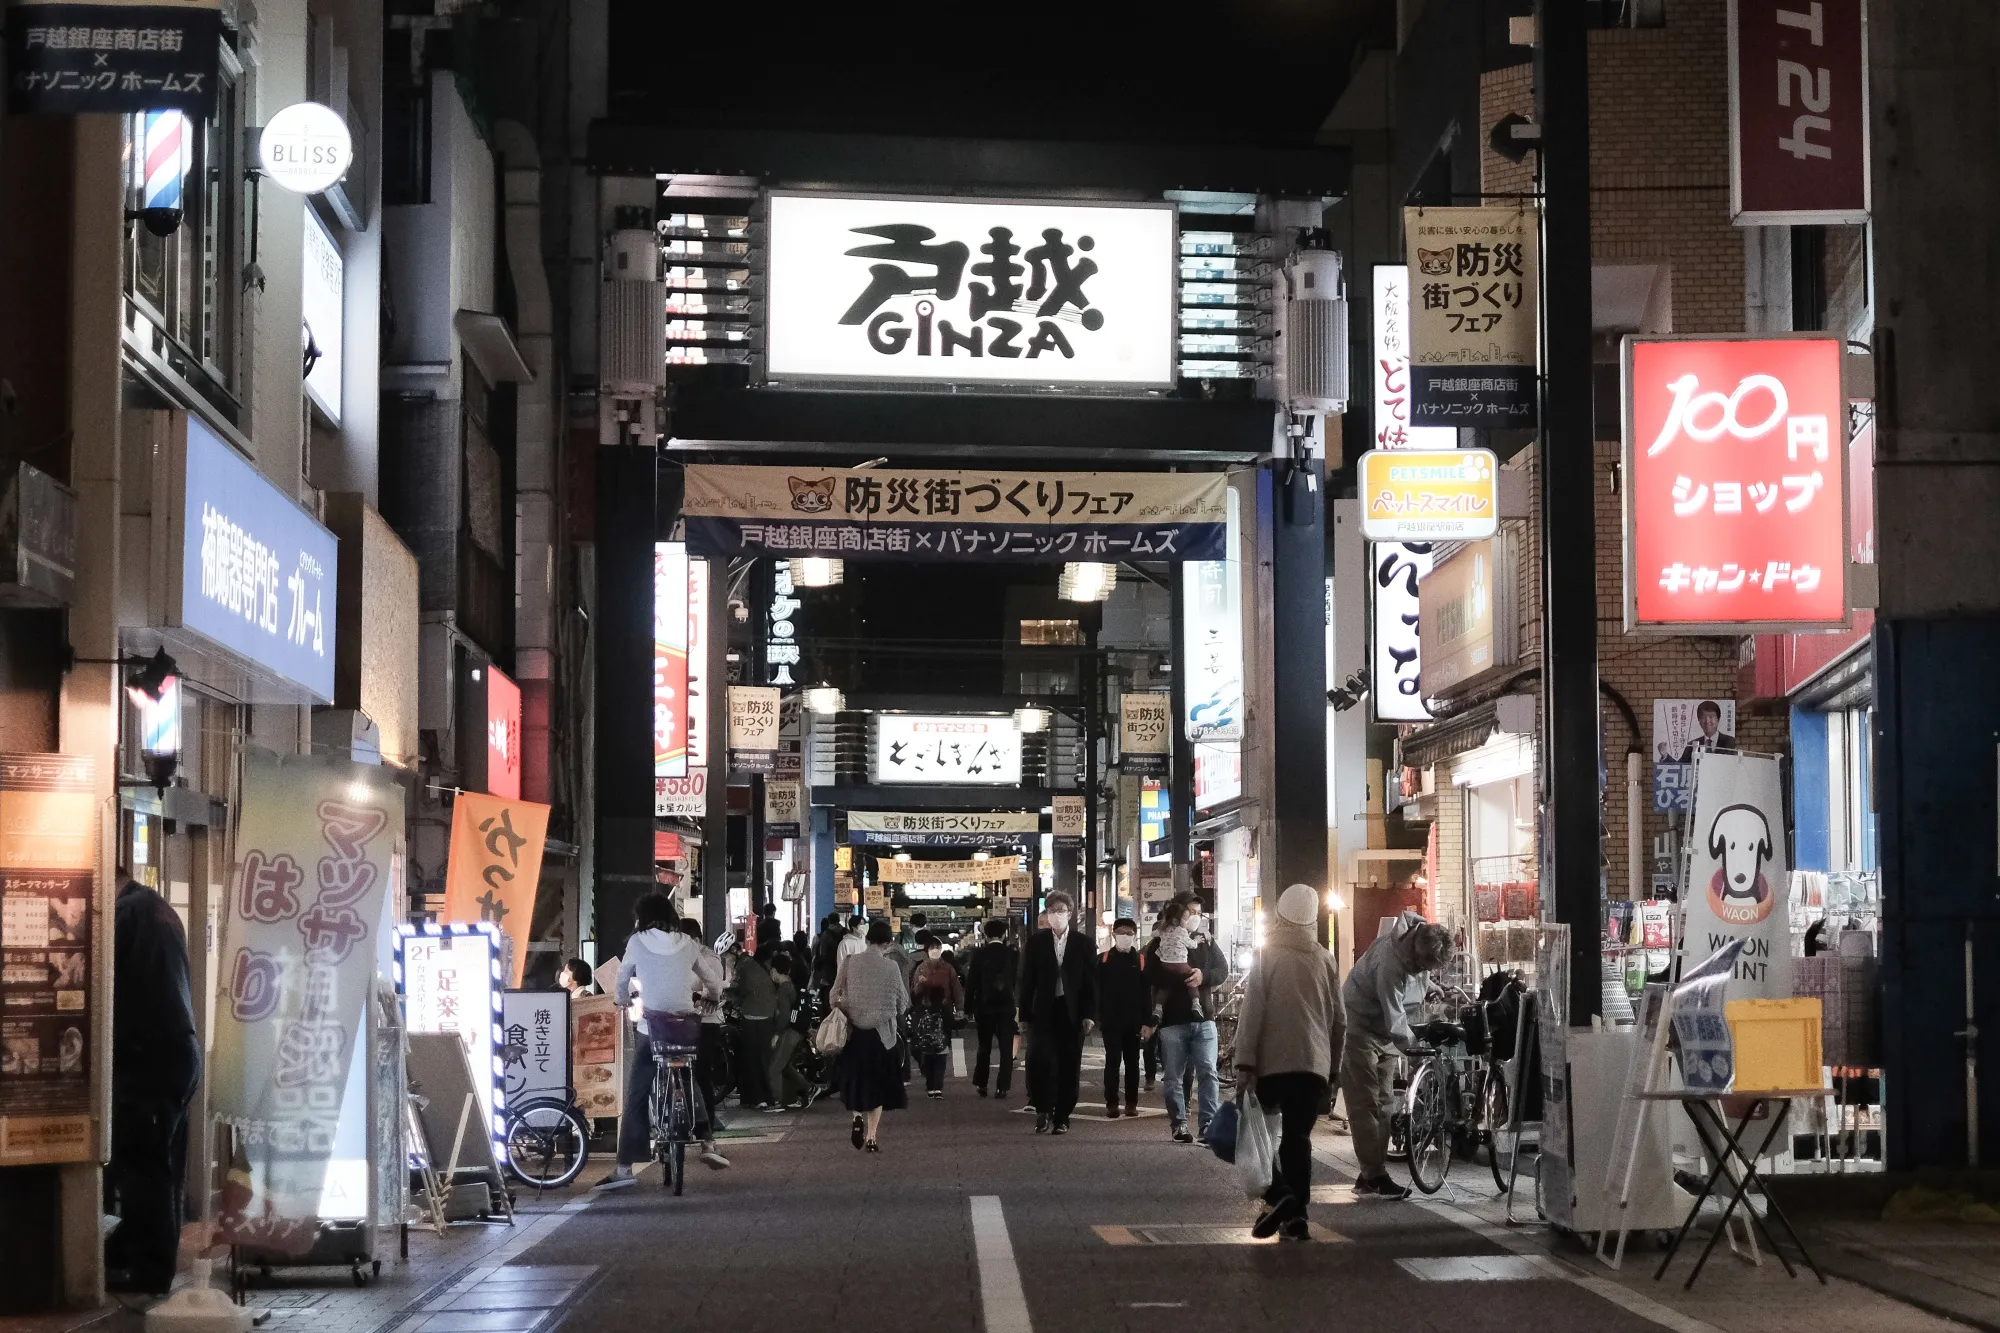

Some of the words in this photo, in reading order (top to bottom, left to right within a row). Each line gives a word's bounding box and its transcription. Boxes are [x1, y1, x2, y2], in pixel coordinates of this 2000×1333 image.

[26, 28, 184, 51] 戸越銀座商店街
[122, 72, 205, 94] ホームズ
[272, 144, 338, 164] BLISS
[1456, 242, 1524, 277] 防災
[838, 223, 1104, 331] 戸越
[1422, 281, 1524, 310] 街づくり
[867, 300, 1076, 359] GINZA
[1445, 313, 1503, 333] フェア
[1428, 378, 1519, 392] 戸越銀座商店街
[1415, 402, 1483, 416] パナソニック
[1486, 402, 1530, 415] ホームズ
[845, 476, 1134, 517] 防災街づくりフェア
[1372, 491, 1488, 513] ペットスマイル
[1672, 471, 1824, 517] ショップ
[1083, 529, 1179, 554] ホームズ
[201, 501, 279, 635] 補聴器専門店
[748, 700, 774, 714] 防災
[1140, 707, 1165, 721] 防災
[733, 716, 774, 727] 街づくり
[742, 727, 765, 736] フェア
[1127, 722, 1165, 733] 街づくり
[1135, 733, 1157, 742] フェア
[903, 816, 1005, 830] 防災街づくりフェア
[986, 834, 1021, 844] ホームズ
[1722, 904, 1760, 921] WAON
[231, 848, 304, 1023] はり
[411, 945, 437, 961] 2F
[534, 1009, 551, 1073] 焼き立て
